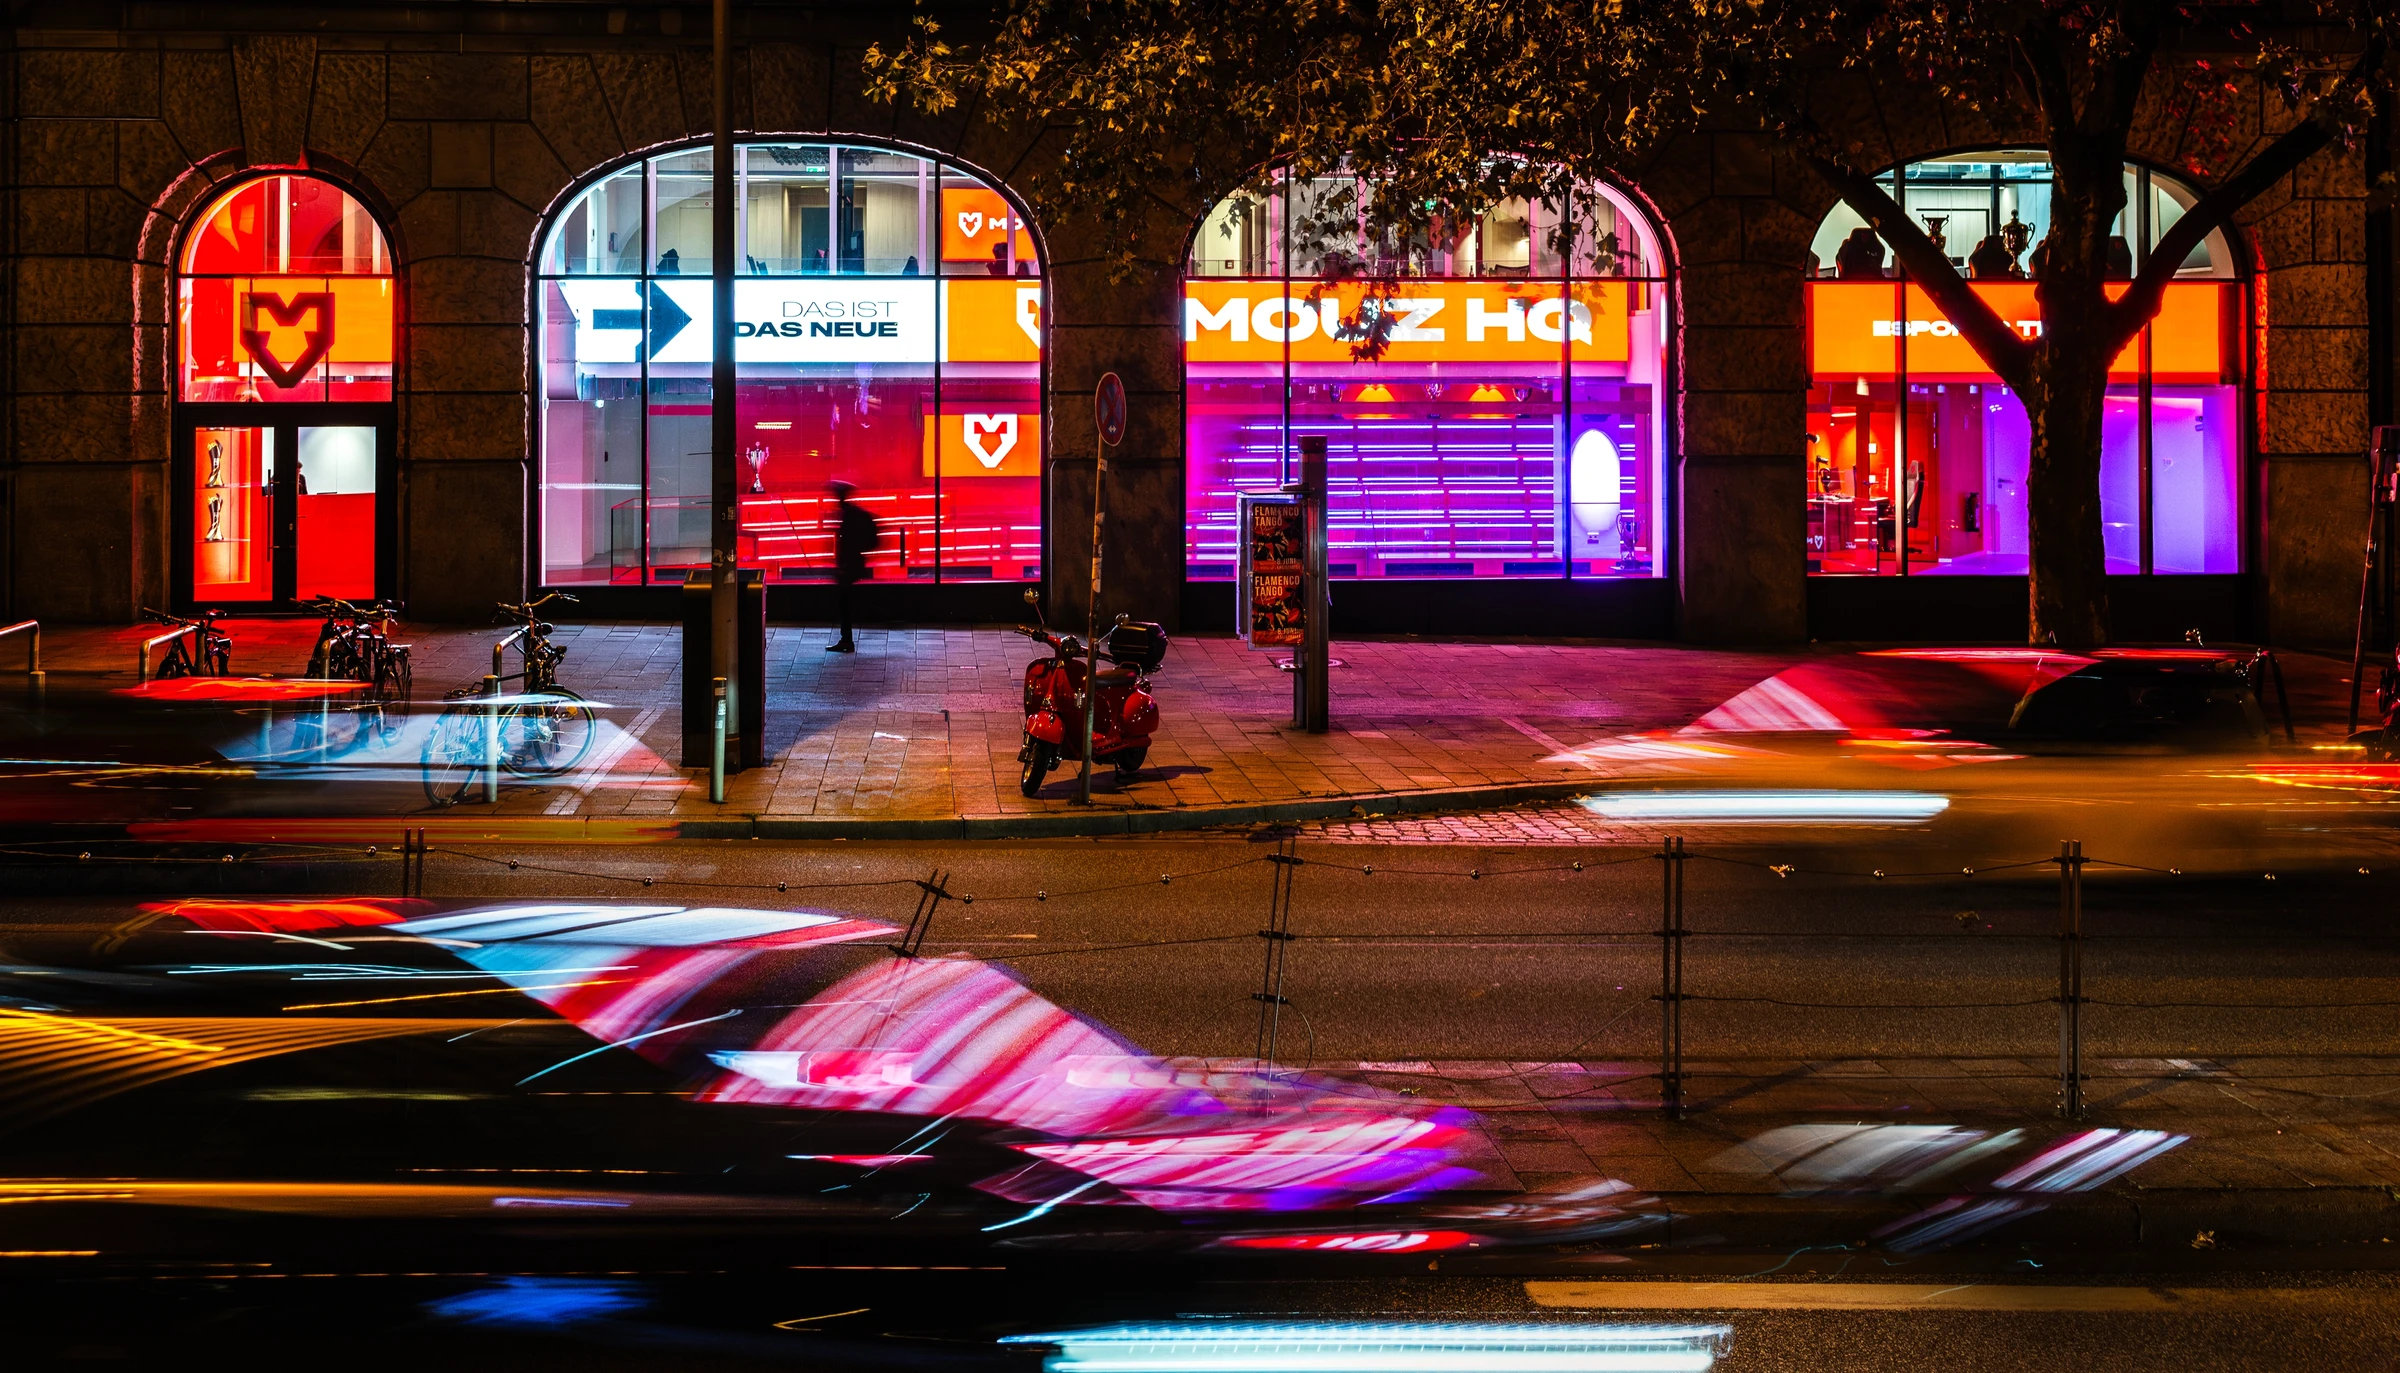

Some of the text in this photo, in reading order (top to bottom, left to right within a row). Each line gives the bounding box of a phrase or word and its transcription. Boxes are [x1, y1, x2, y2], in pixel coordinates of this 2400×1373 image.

[782, 301, 899, 318] DAS IST
[1466, 297, 1593, 347] HQ
[735, 321, 898, 338] DAS NEUE
[1254, 506, 1299, 516] FLAMENCO
[1254, 516, 1283, 526] TANGO
[1254, 575, 1299, 586] FLAMENCO
[1254, 586, 1283, 596] TANGO
